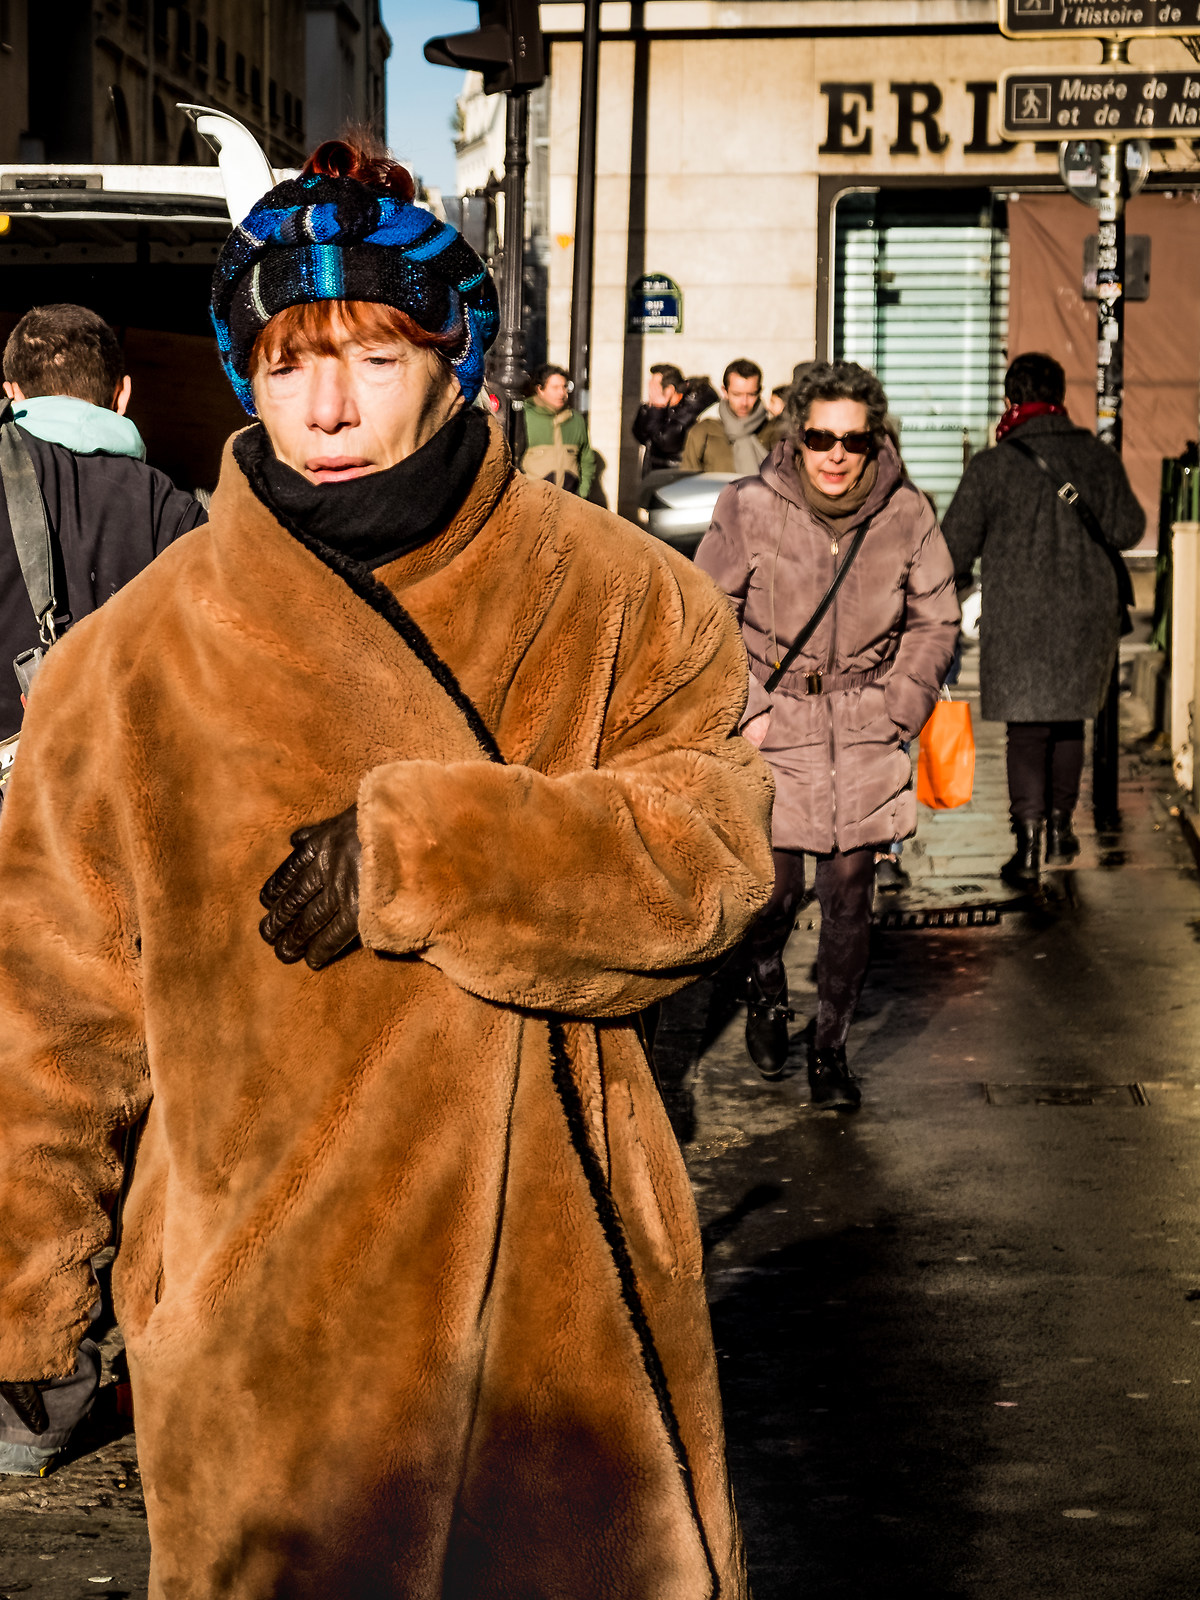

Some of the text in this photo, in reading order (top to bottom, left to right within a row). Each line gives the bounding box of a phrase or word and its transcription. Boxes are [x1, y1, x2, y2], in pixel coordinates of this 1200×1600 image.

[1060, 5, 1144, 26] l'Histoire
[1158, 4, 1182, 23] de
[1058, 78, 1128, 101] Musée
[1142, 77, 1168, 100] de
[1057, 106, 1080, 126] et
[1094, 103, 1121, 126] de
[1134, 102, 1155, 125] la
